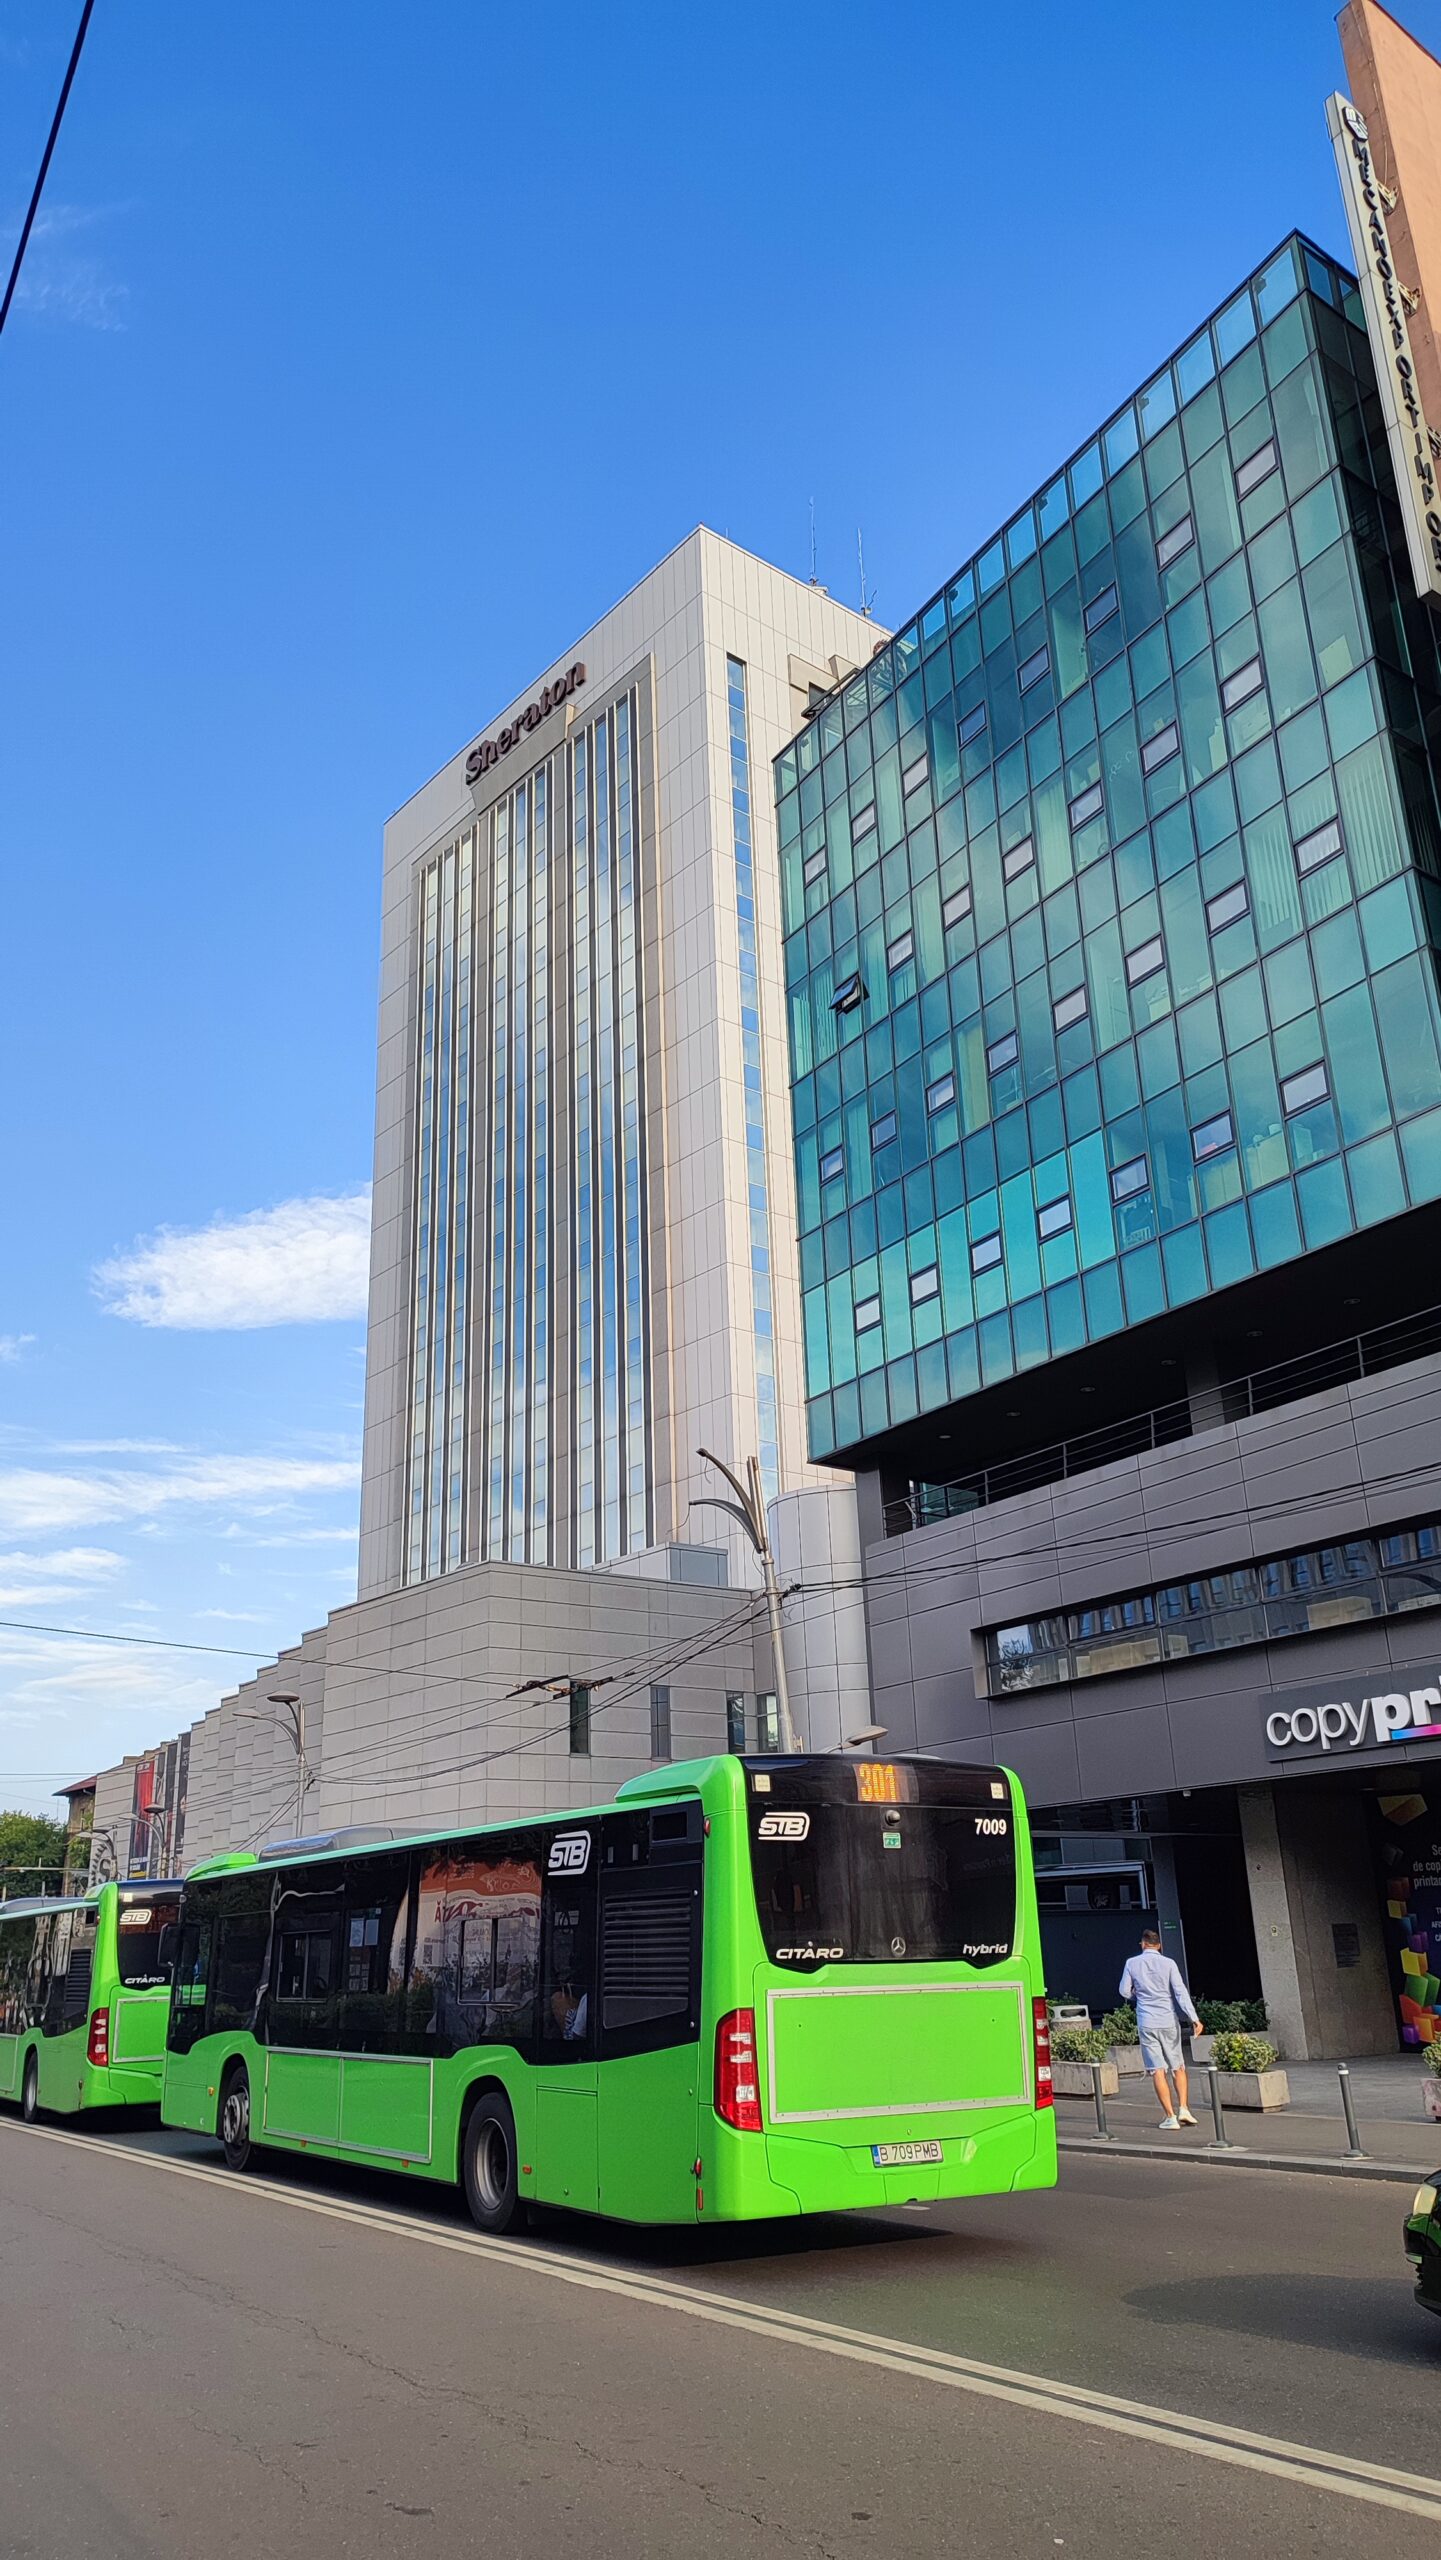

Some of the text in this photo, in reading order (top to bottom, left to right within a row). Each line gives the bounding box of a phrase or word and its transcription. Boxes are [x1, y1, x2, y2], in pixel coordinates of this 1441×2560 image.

[466, 662, 585, 785] Sheraton
[859, 1764, 897, 1802] 301
[758, 1815, 806, 1837] STB
[974, 1818, 1007, 1835] 7009
[547, 1835, 588, 1871] STB
[1412, 1860, 1424, 1872] de
[119, 1911, 150, 1923] STB
[776, 1947, 844, 1959] CITARO
[963, 1943, 1007, 1957] hybrid
[124, 1976, 165, 1984] CITARO
